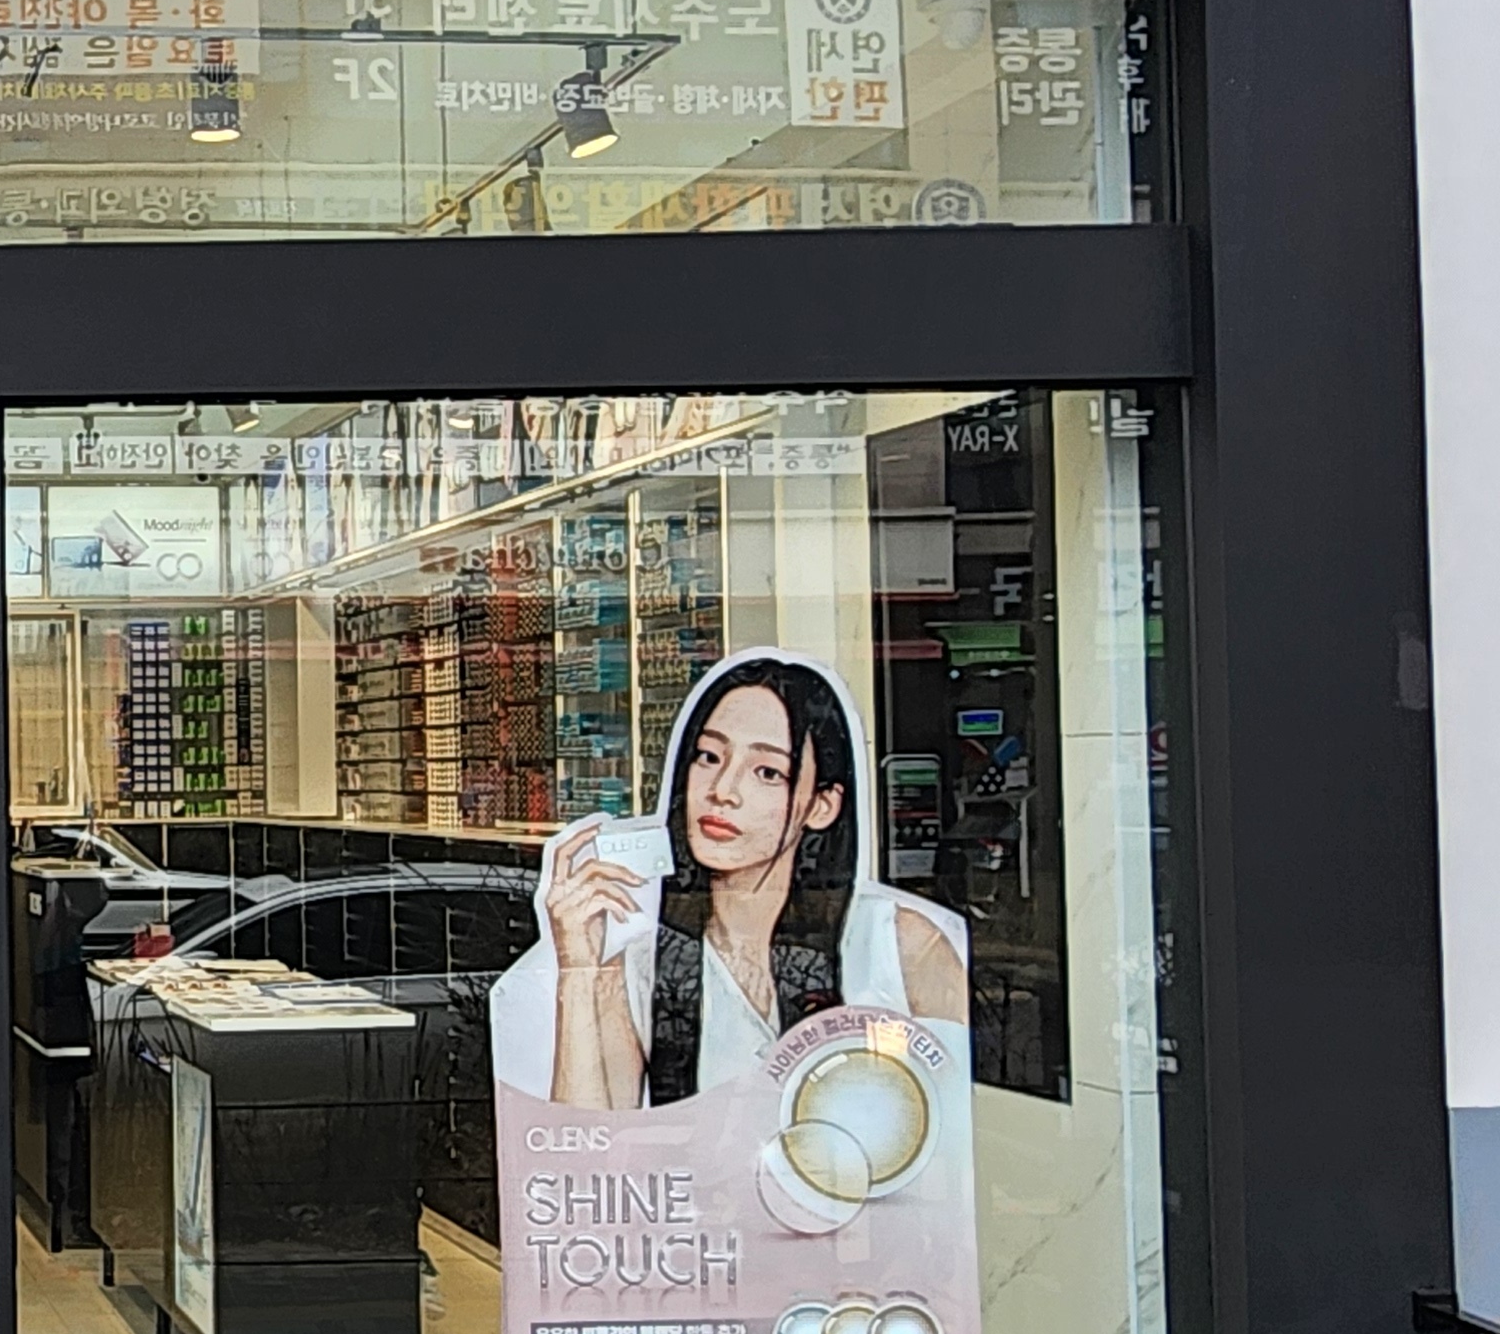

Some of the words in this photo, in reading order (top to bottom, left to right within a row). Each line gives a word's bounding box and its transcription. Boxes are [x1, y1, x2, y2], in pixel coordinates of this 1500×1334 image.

[525, 1125, 612, 1153] OLENS
[525, 1172, 696, 1226] SHINE
[526, 1232, 738, 1290] TOUCH
